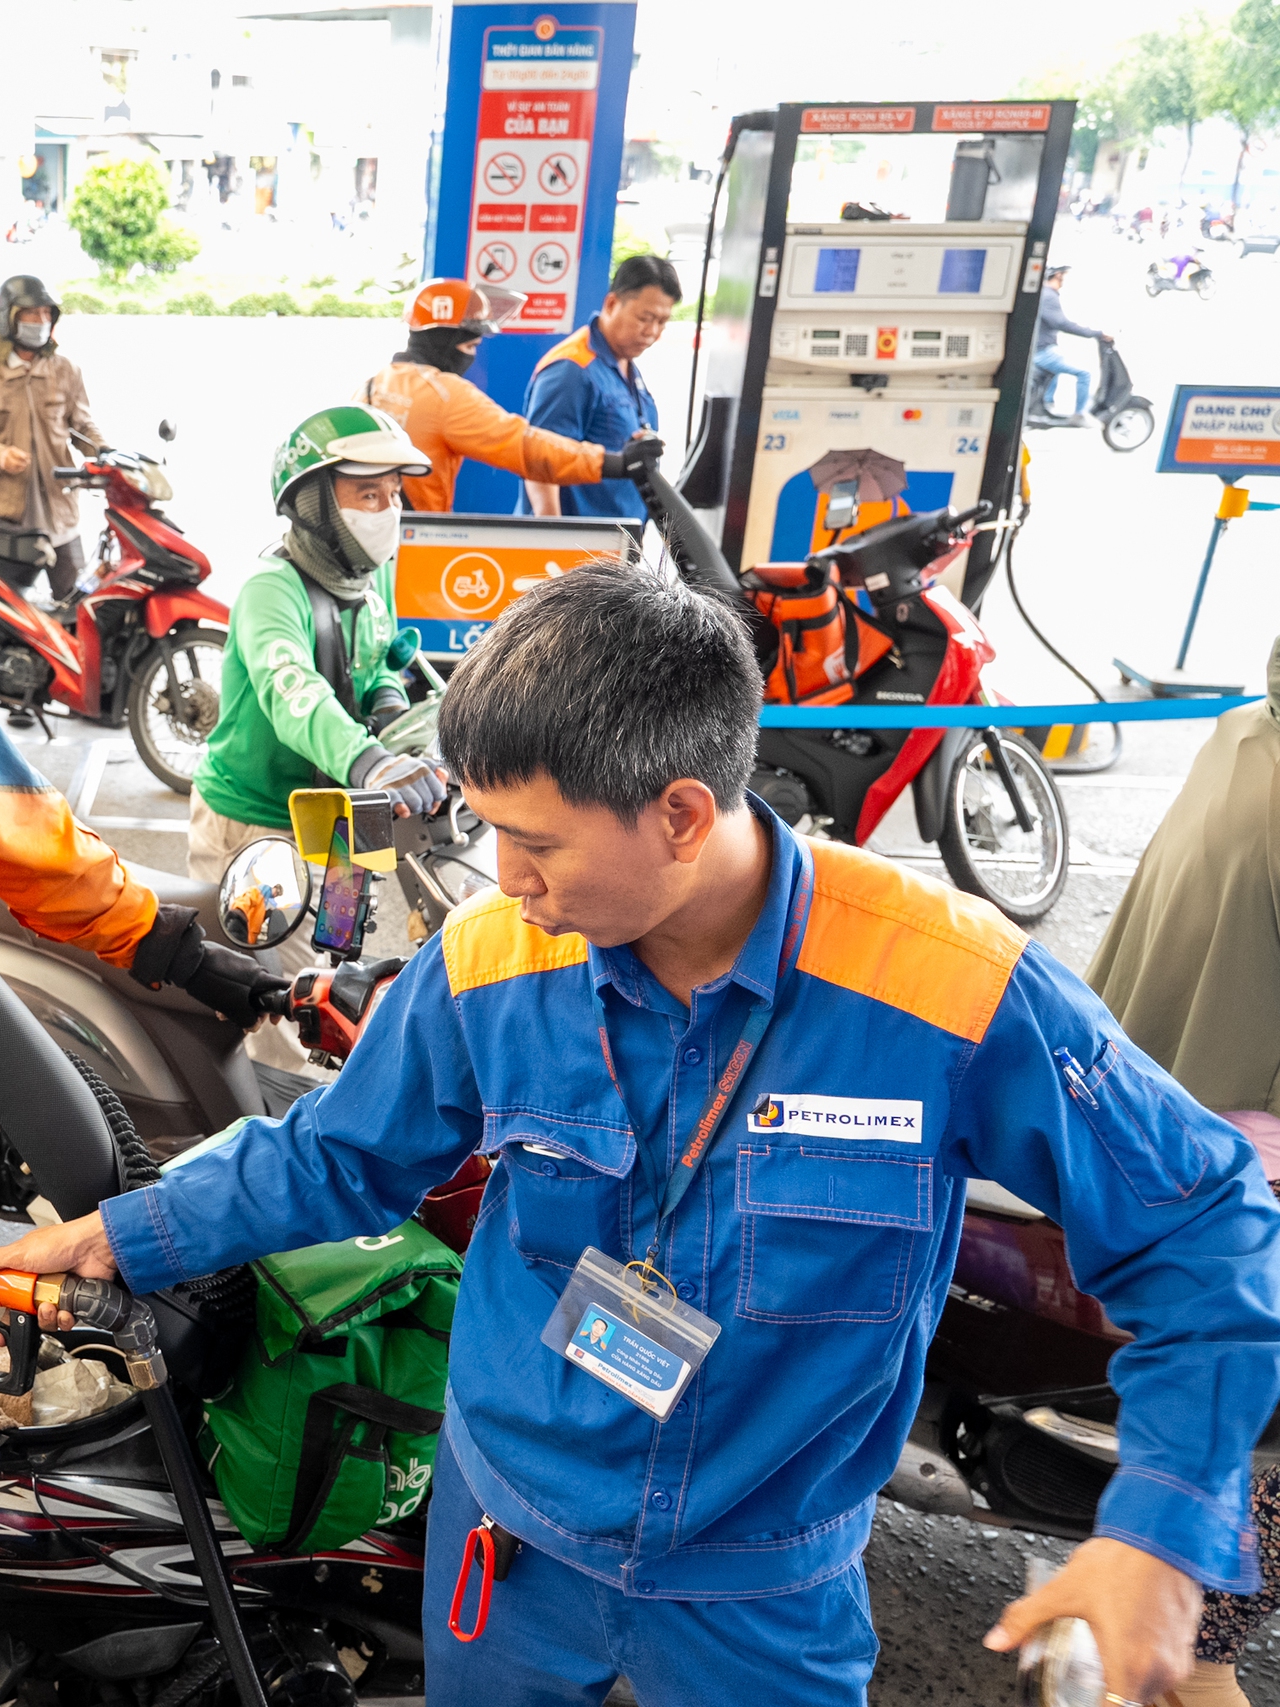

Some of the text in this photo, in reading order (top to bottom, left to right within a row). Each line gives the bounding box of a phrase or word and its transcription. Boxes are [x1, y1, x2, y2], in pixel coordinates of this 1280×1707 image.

[504, 113, 535, 134] CỦA
[764, 435, 786, 450] 23
[956, 437, 979, 453] 24
[681, 1039, 753, 1168] Petrolimex SAIGON
[788, 1110, 916, 1128] PETROLIMEX
[598, 1362, 632, 1388] Petrolimex
